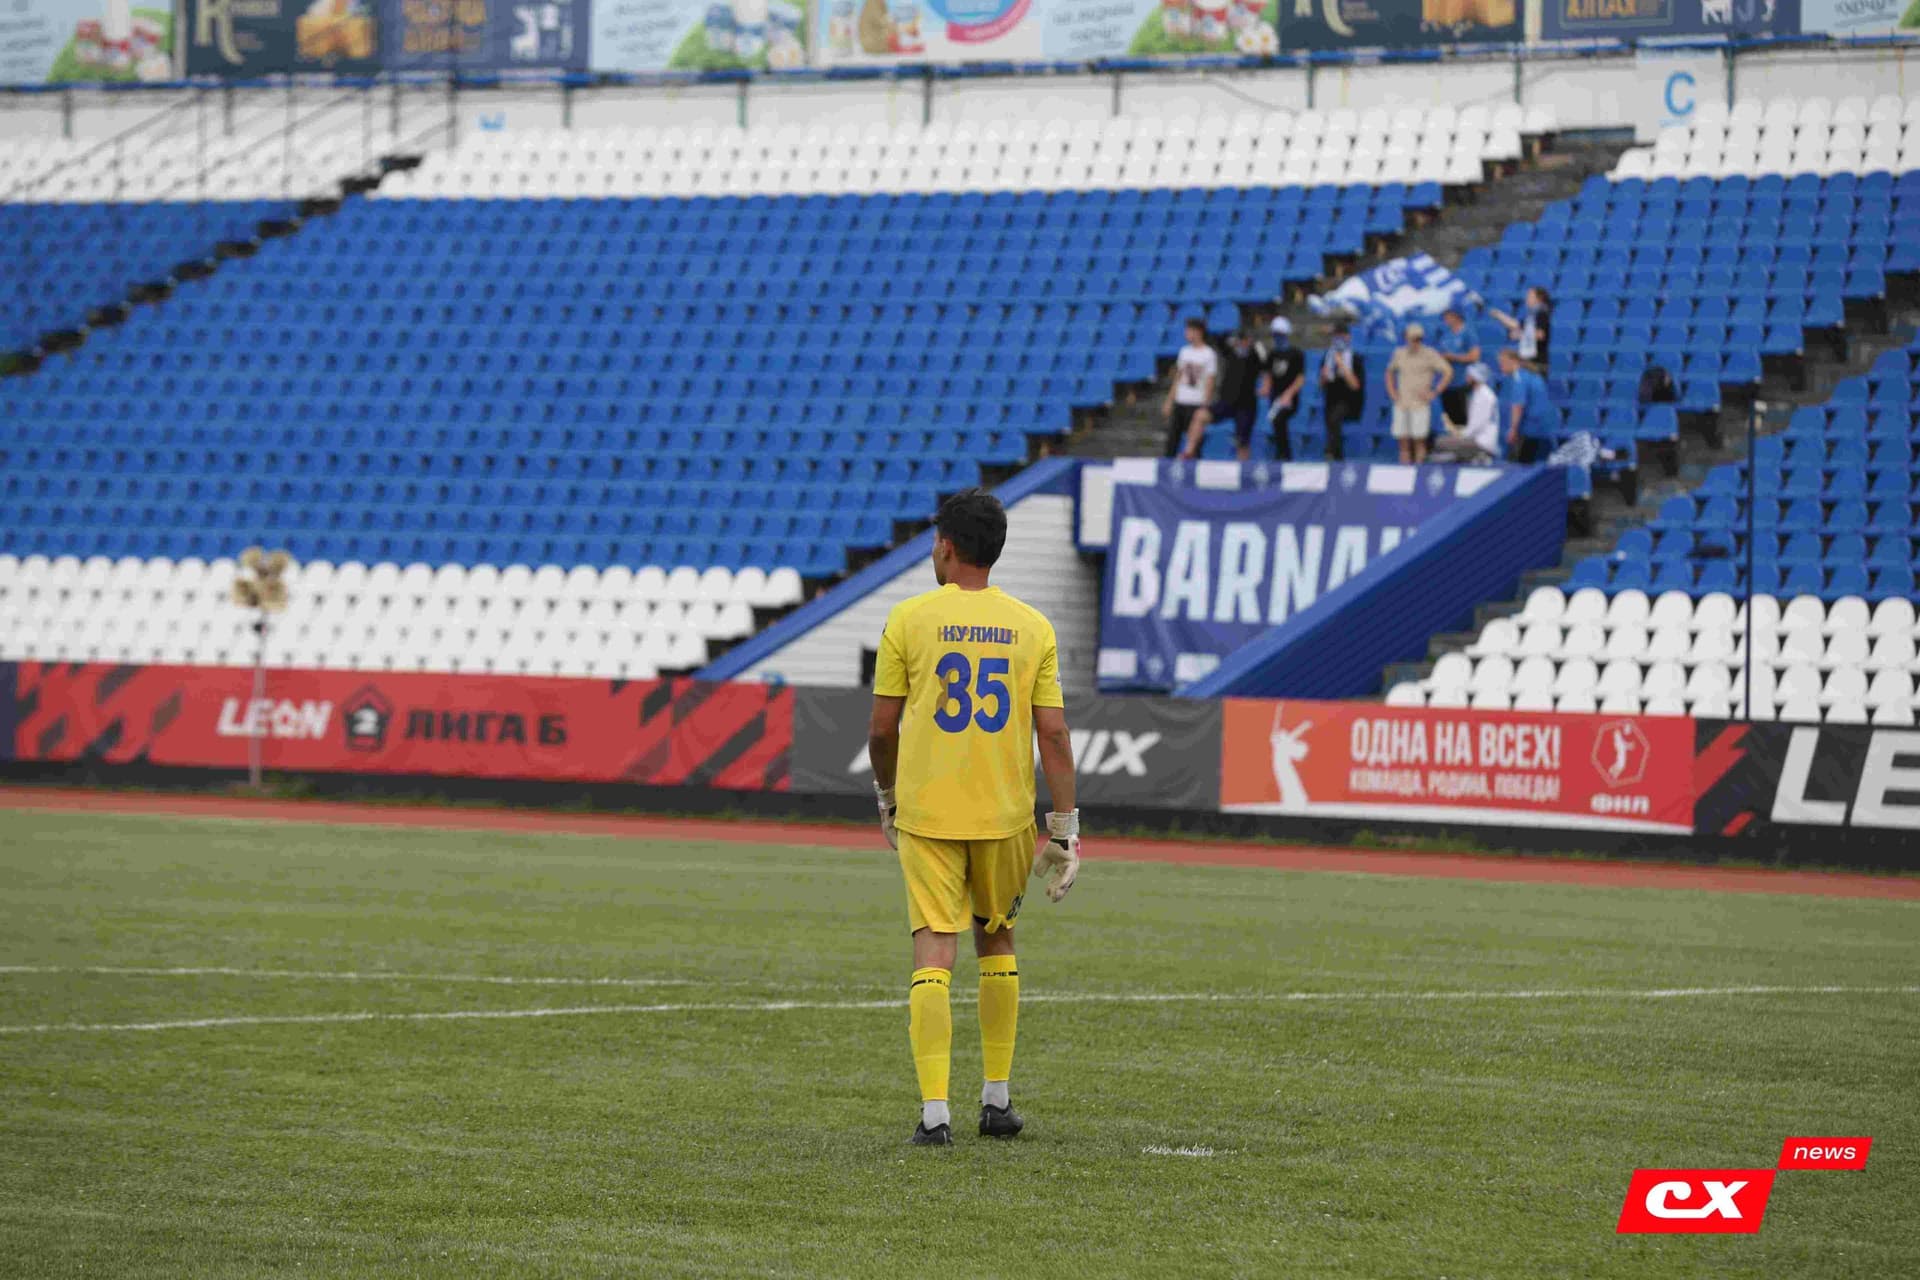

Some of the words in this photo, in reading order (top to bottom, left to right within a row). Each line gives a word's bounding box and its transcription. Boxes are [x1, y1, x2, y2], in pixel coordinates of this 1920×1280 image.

[1112, 516, 1418, 625] BARNA
[933, 651, 1011, 733] 35
[217, 697, 332, 739] LEON
[405, 707, 526, 746] ЛИГА
[538, 714, 567, 745] Б
[1351, 718, 1427, 766] ОДНА
[1434, 721, 1473, 767] НА
[1479, 723, 1561, 769] ВСЕХ!
